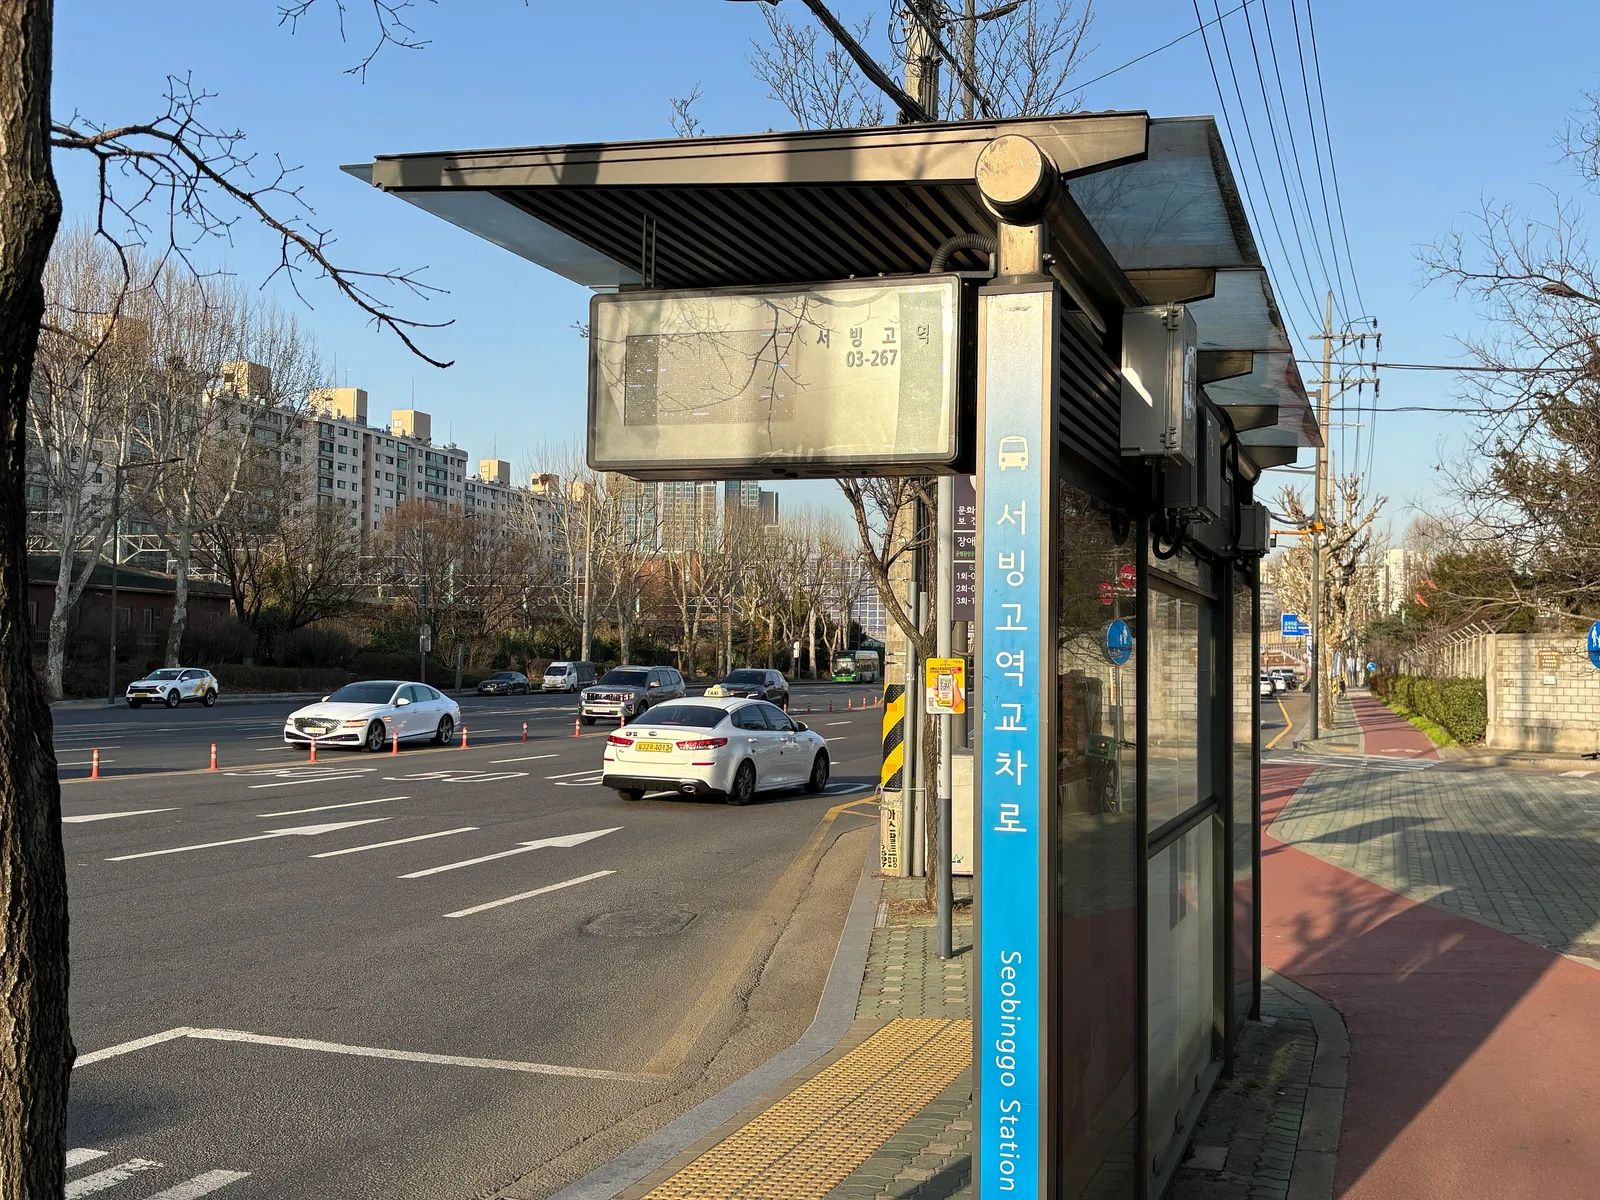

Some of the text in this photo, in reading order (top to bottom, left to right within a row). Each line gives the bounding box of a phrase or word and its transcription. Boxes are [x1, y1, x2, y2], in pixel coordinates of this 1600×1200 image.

[846, 349, 898, 368] 03-267
[994, 500, 1028, 832] 서빙고역교차로
[996, 950, 1022, 1191] Seobinggo Station
